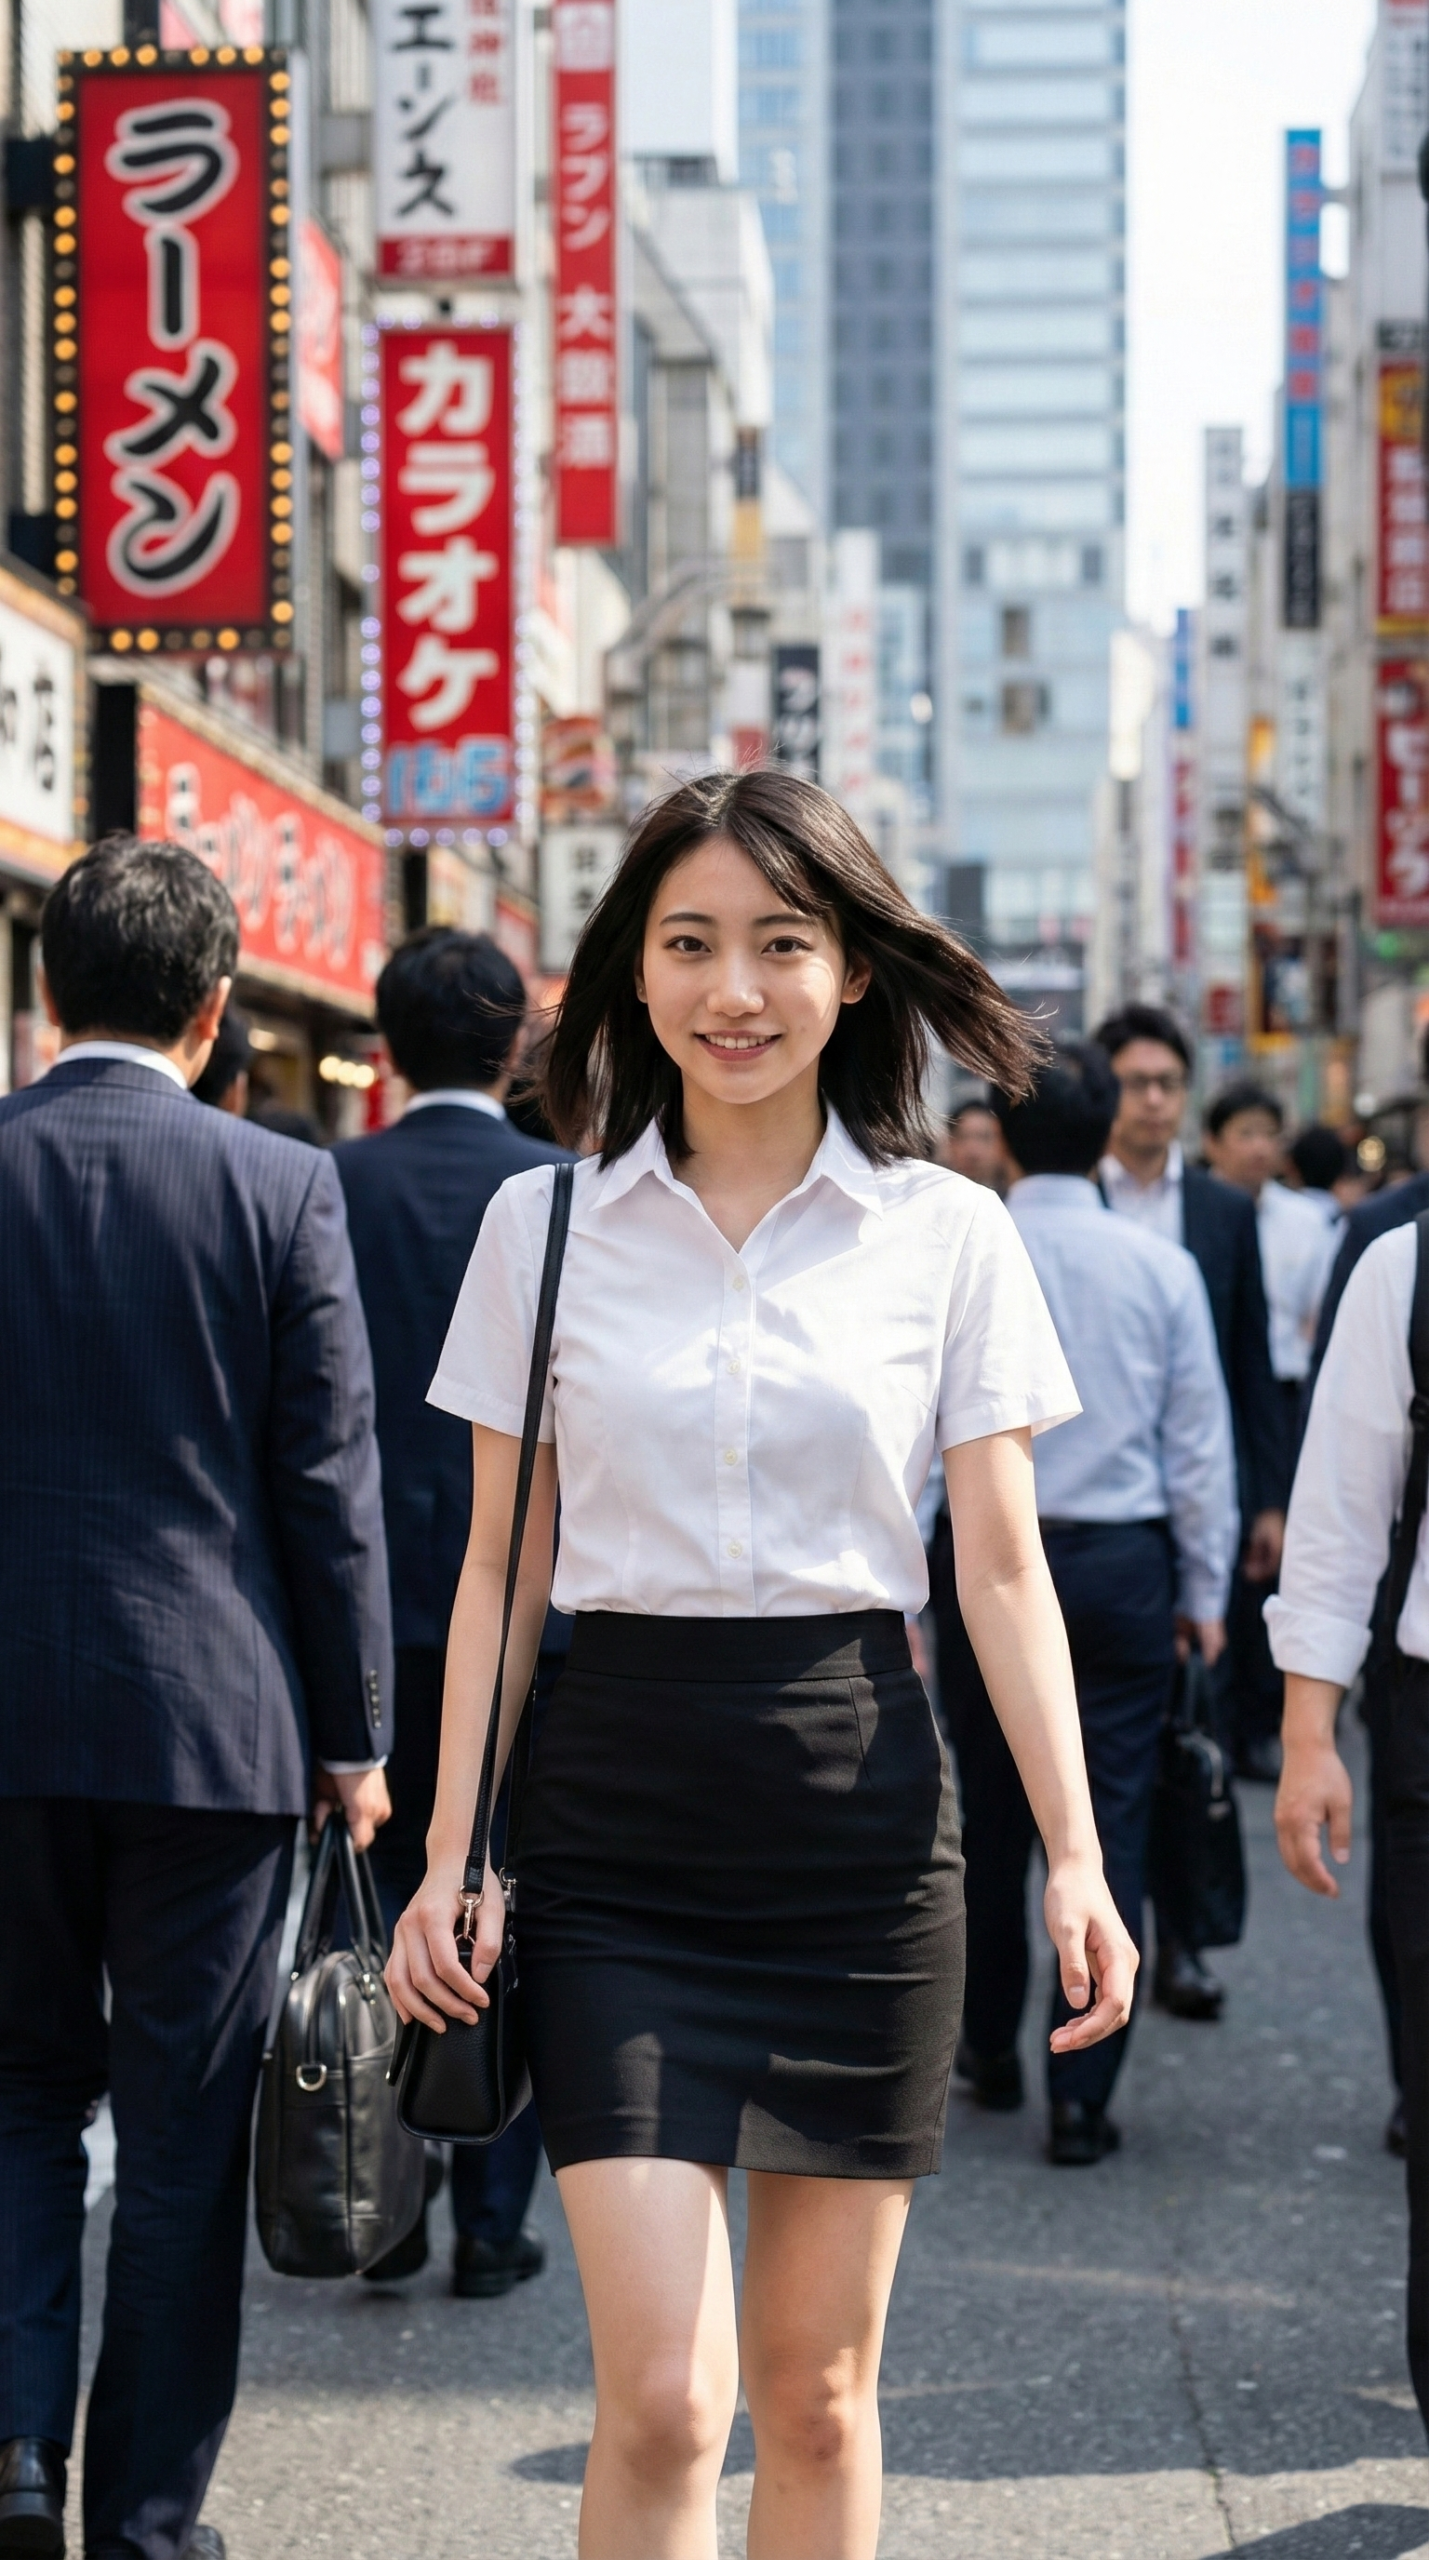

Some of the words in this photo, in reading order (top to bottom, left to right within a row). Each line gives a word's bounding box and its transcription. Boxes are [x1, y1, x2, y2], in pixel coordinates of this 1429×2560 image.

[105, 98, 241, 598] ラーメン
[397, 342, 500, 731] カラオケ
